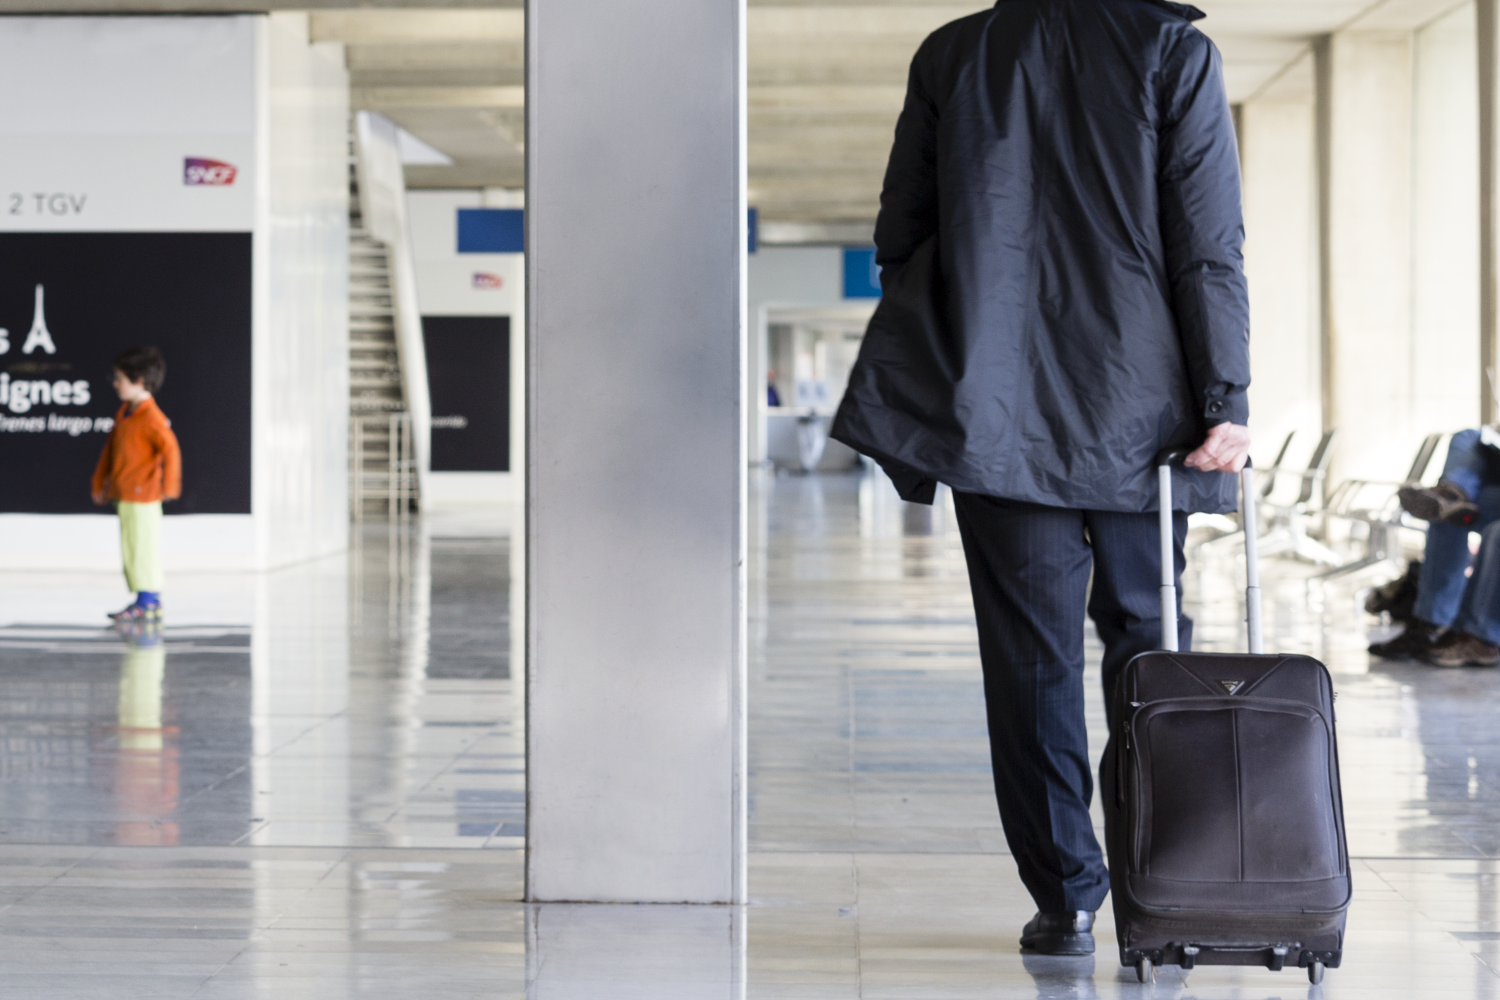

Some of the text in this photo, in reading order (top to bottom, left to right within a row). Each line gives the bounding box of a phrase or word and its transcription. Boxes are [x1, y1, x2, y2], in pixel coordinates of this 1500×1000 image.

[9, 192, 23, 215] 2
[32, 192, 87, 216] TGV
[47, 414, 92, 436] largo
